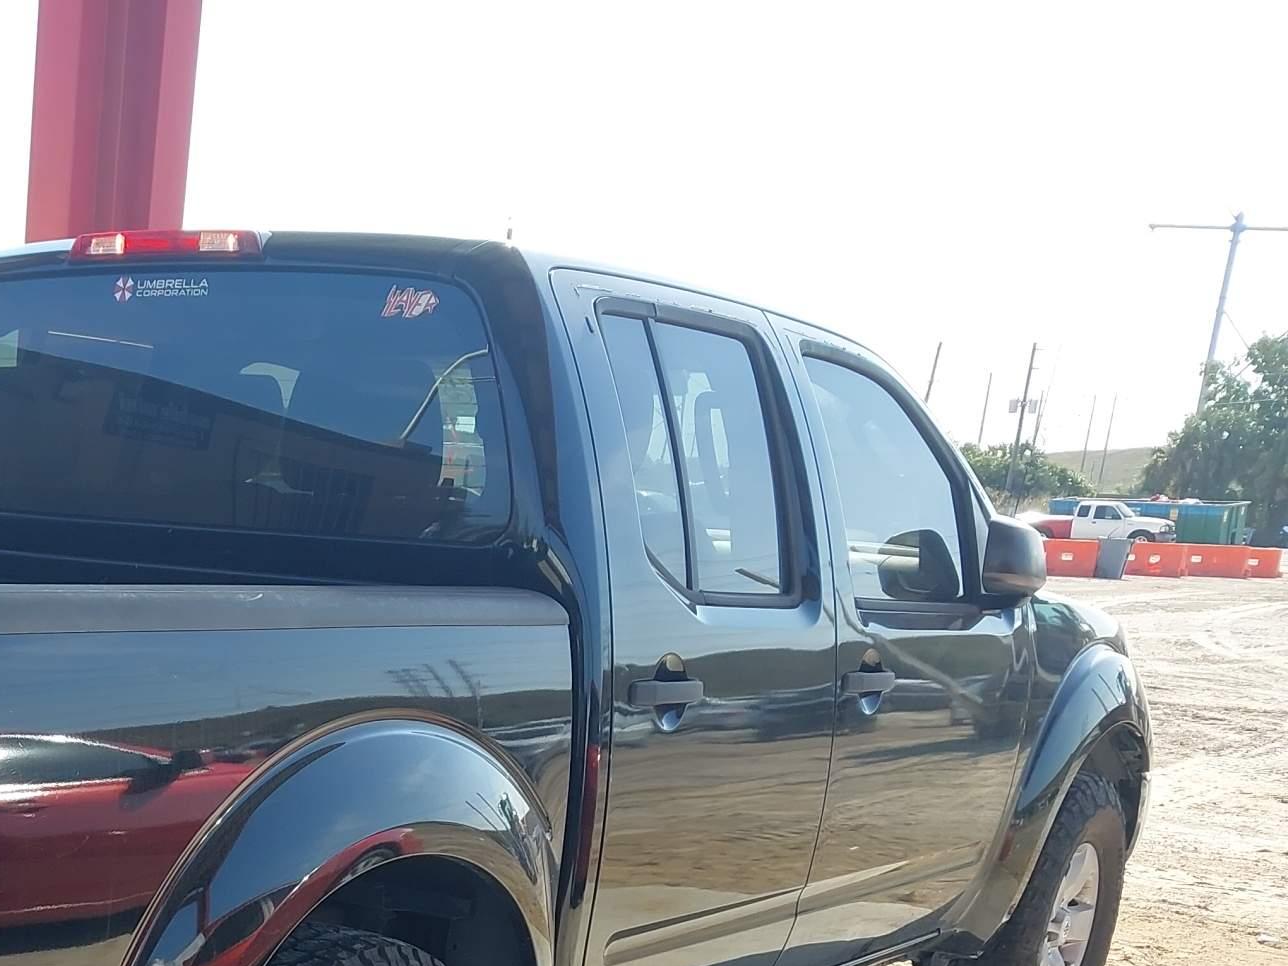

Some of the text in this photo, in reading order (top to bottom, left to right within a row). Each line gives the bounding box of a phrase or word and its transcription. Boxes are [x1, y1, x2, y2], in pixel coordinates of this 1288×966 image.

[137, 278, 209, 289] UMBRELLA
[135, 288, 209, 297] CORPORATION
[381, 284, 440, 318] SLAYER
